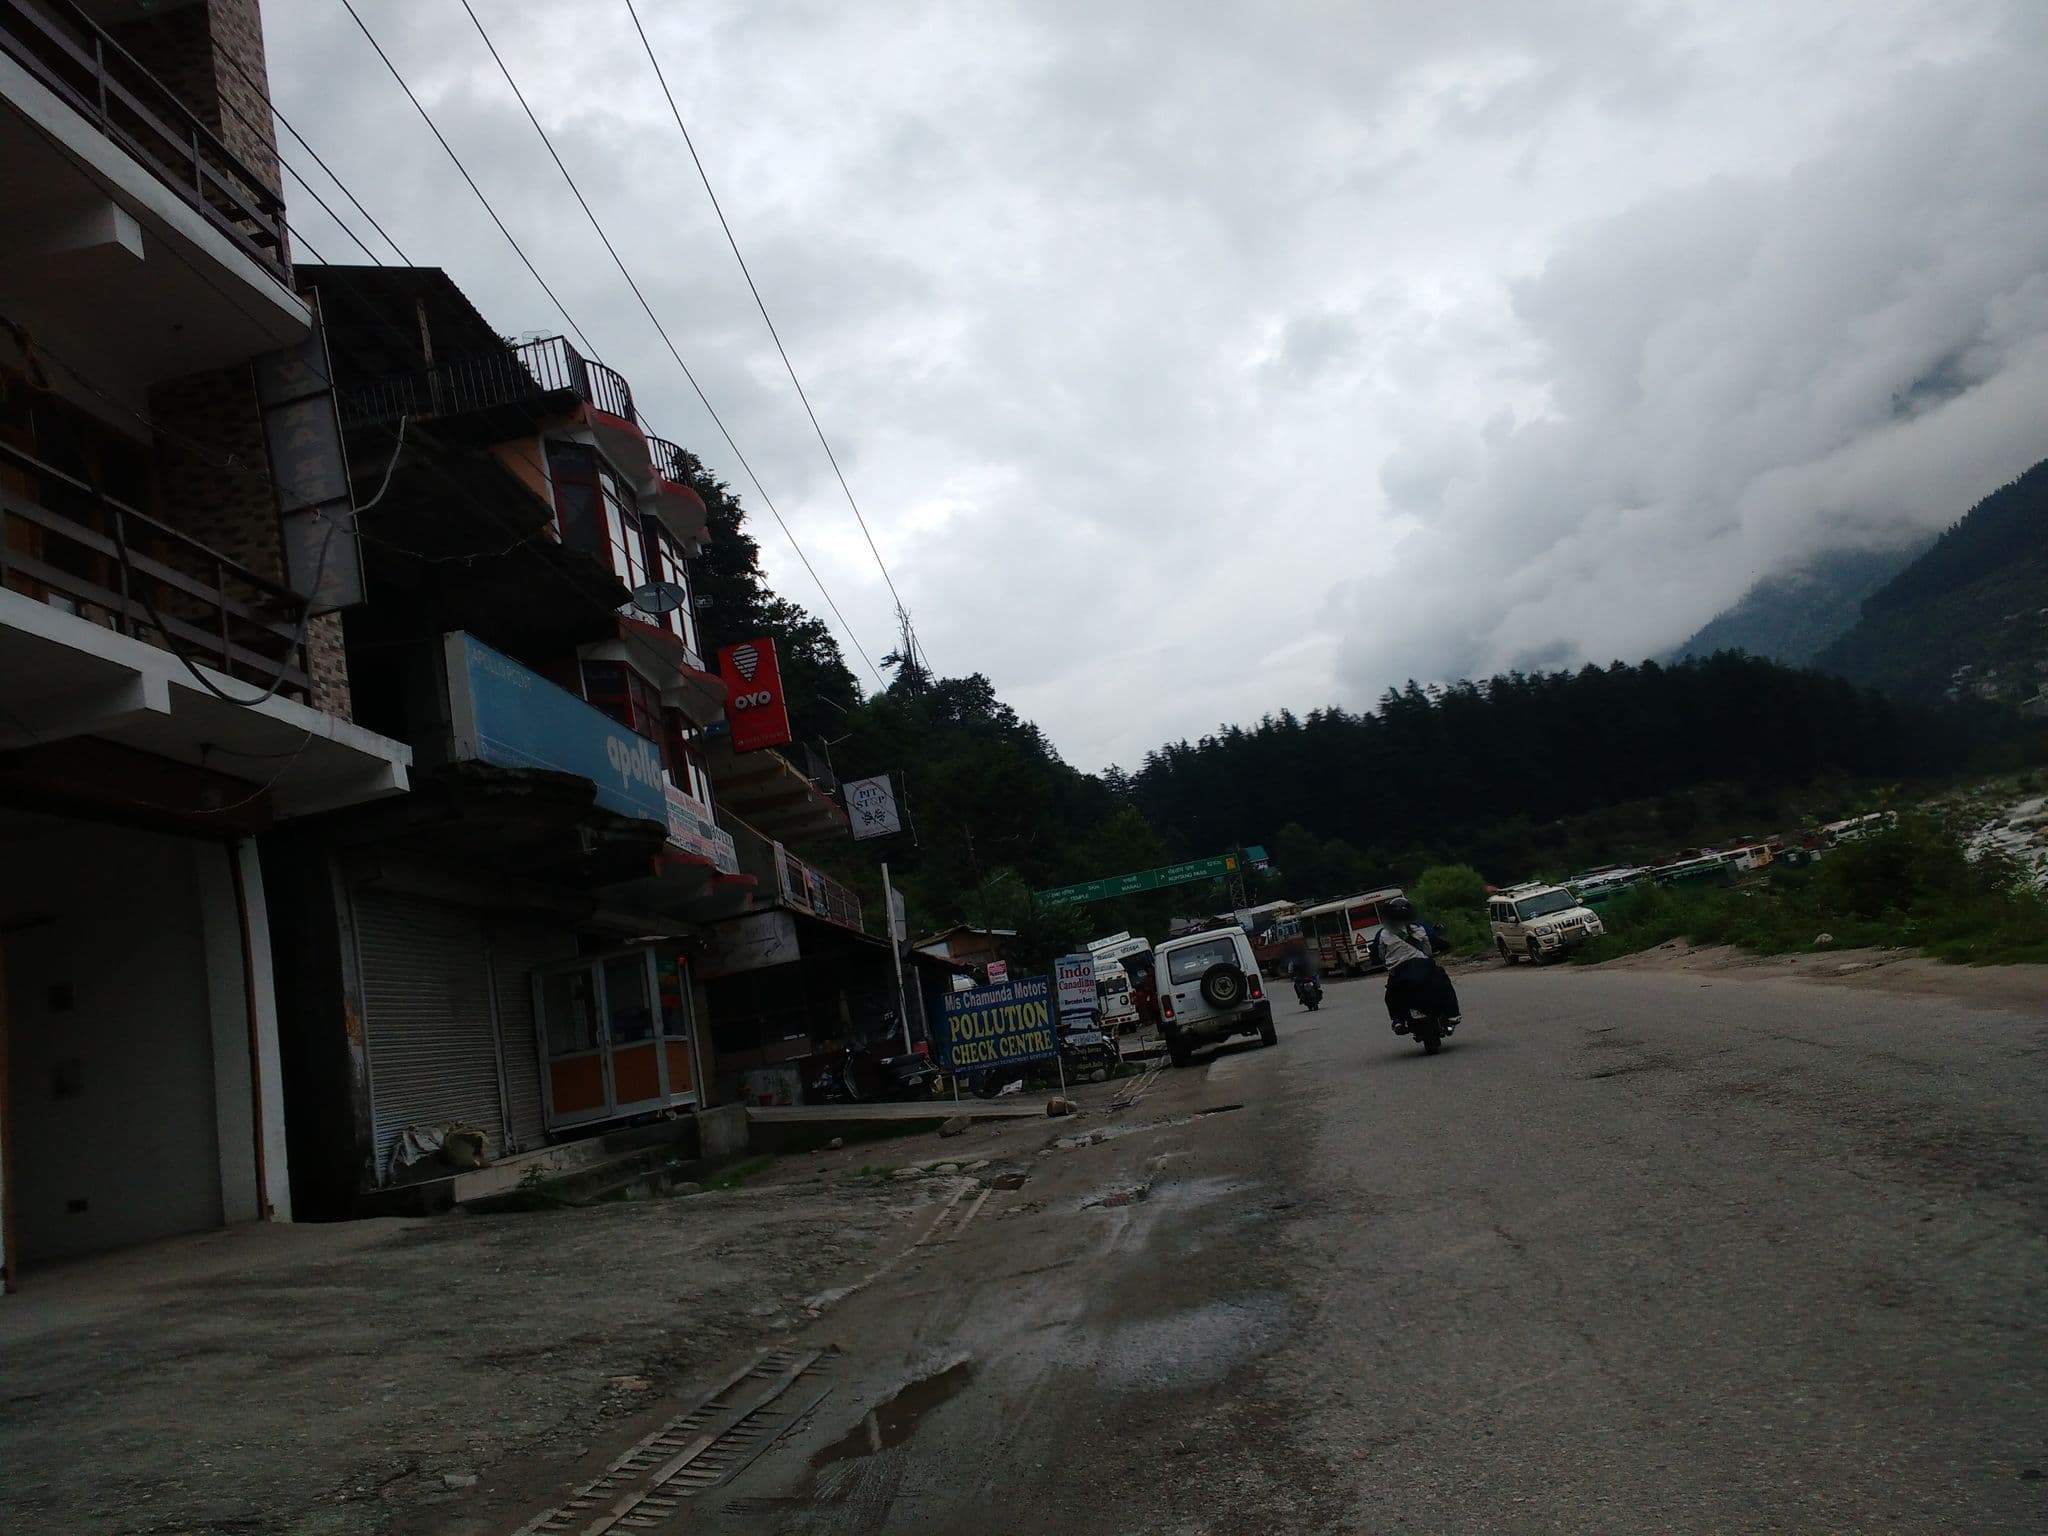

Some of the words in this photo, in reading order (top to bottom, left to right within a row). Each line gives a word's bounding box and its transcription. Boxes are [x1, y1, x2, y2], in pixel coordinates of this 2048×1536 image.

[734, 690, 772, 710] OYO
[606, 736, 662, 792] apollo
[1058, 979, 1095, 991] Canadian
[1059, 965, 1091, 979] Indo
[963, 985, 1012, 1008] Chamunda
[1013, 980, 1048, 999] Motors
[947, 1000, 1050, 1042] POLLUTION
[951, 1040, 998, 1065] CHECK
[1000, 1029, 1053, 1057] CENTRE
